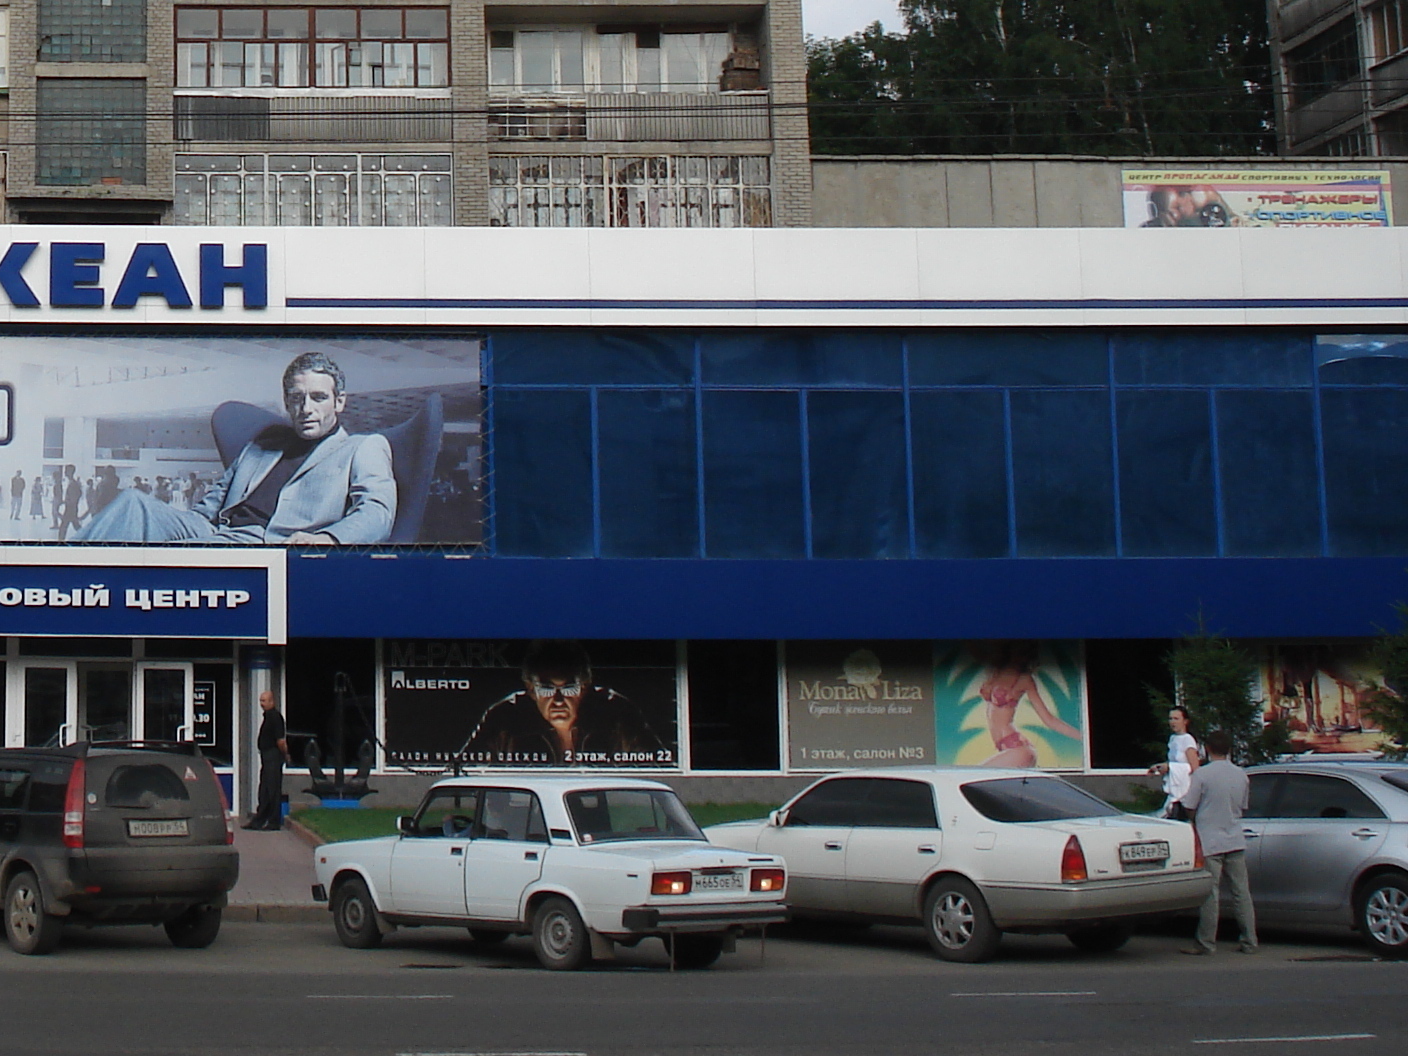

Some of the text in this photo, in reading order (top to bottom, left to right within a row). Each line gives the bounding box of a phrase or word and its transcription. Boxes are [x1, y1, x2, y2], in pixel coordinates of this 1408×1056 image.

[1257, 194, 1379, 205] ТРЕНАЖЕРЫ
[1255, 210, 1386, 221] СПОРТИВНОЕ
[124, 587, 251, 611] ЦЕНТР
[391, 671, 471, 689] ALBERTO
[798, 680, 923, 700] Mona Liza
[564, 750, 673, 764] 2 этаж, салон 22
[801, 747, 924, 761] 1 этаж, салон №3
